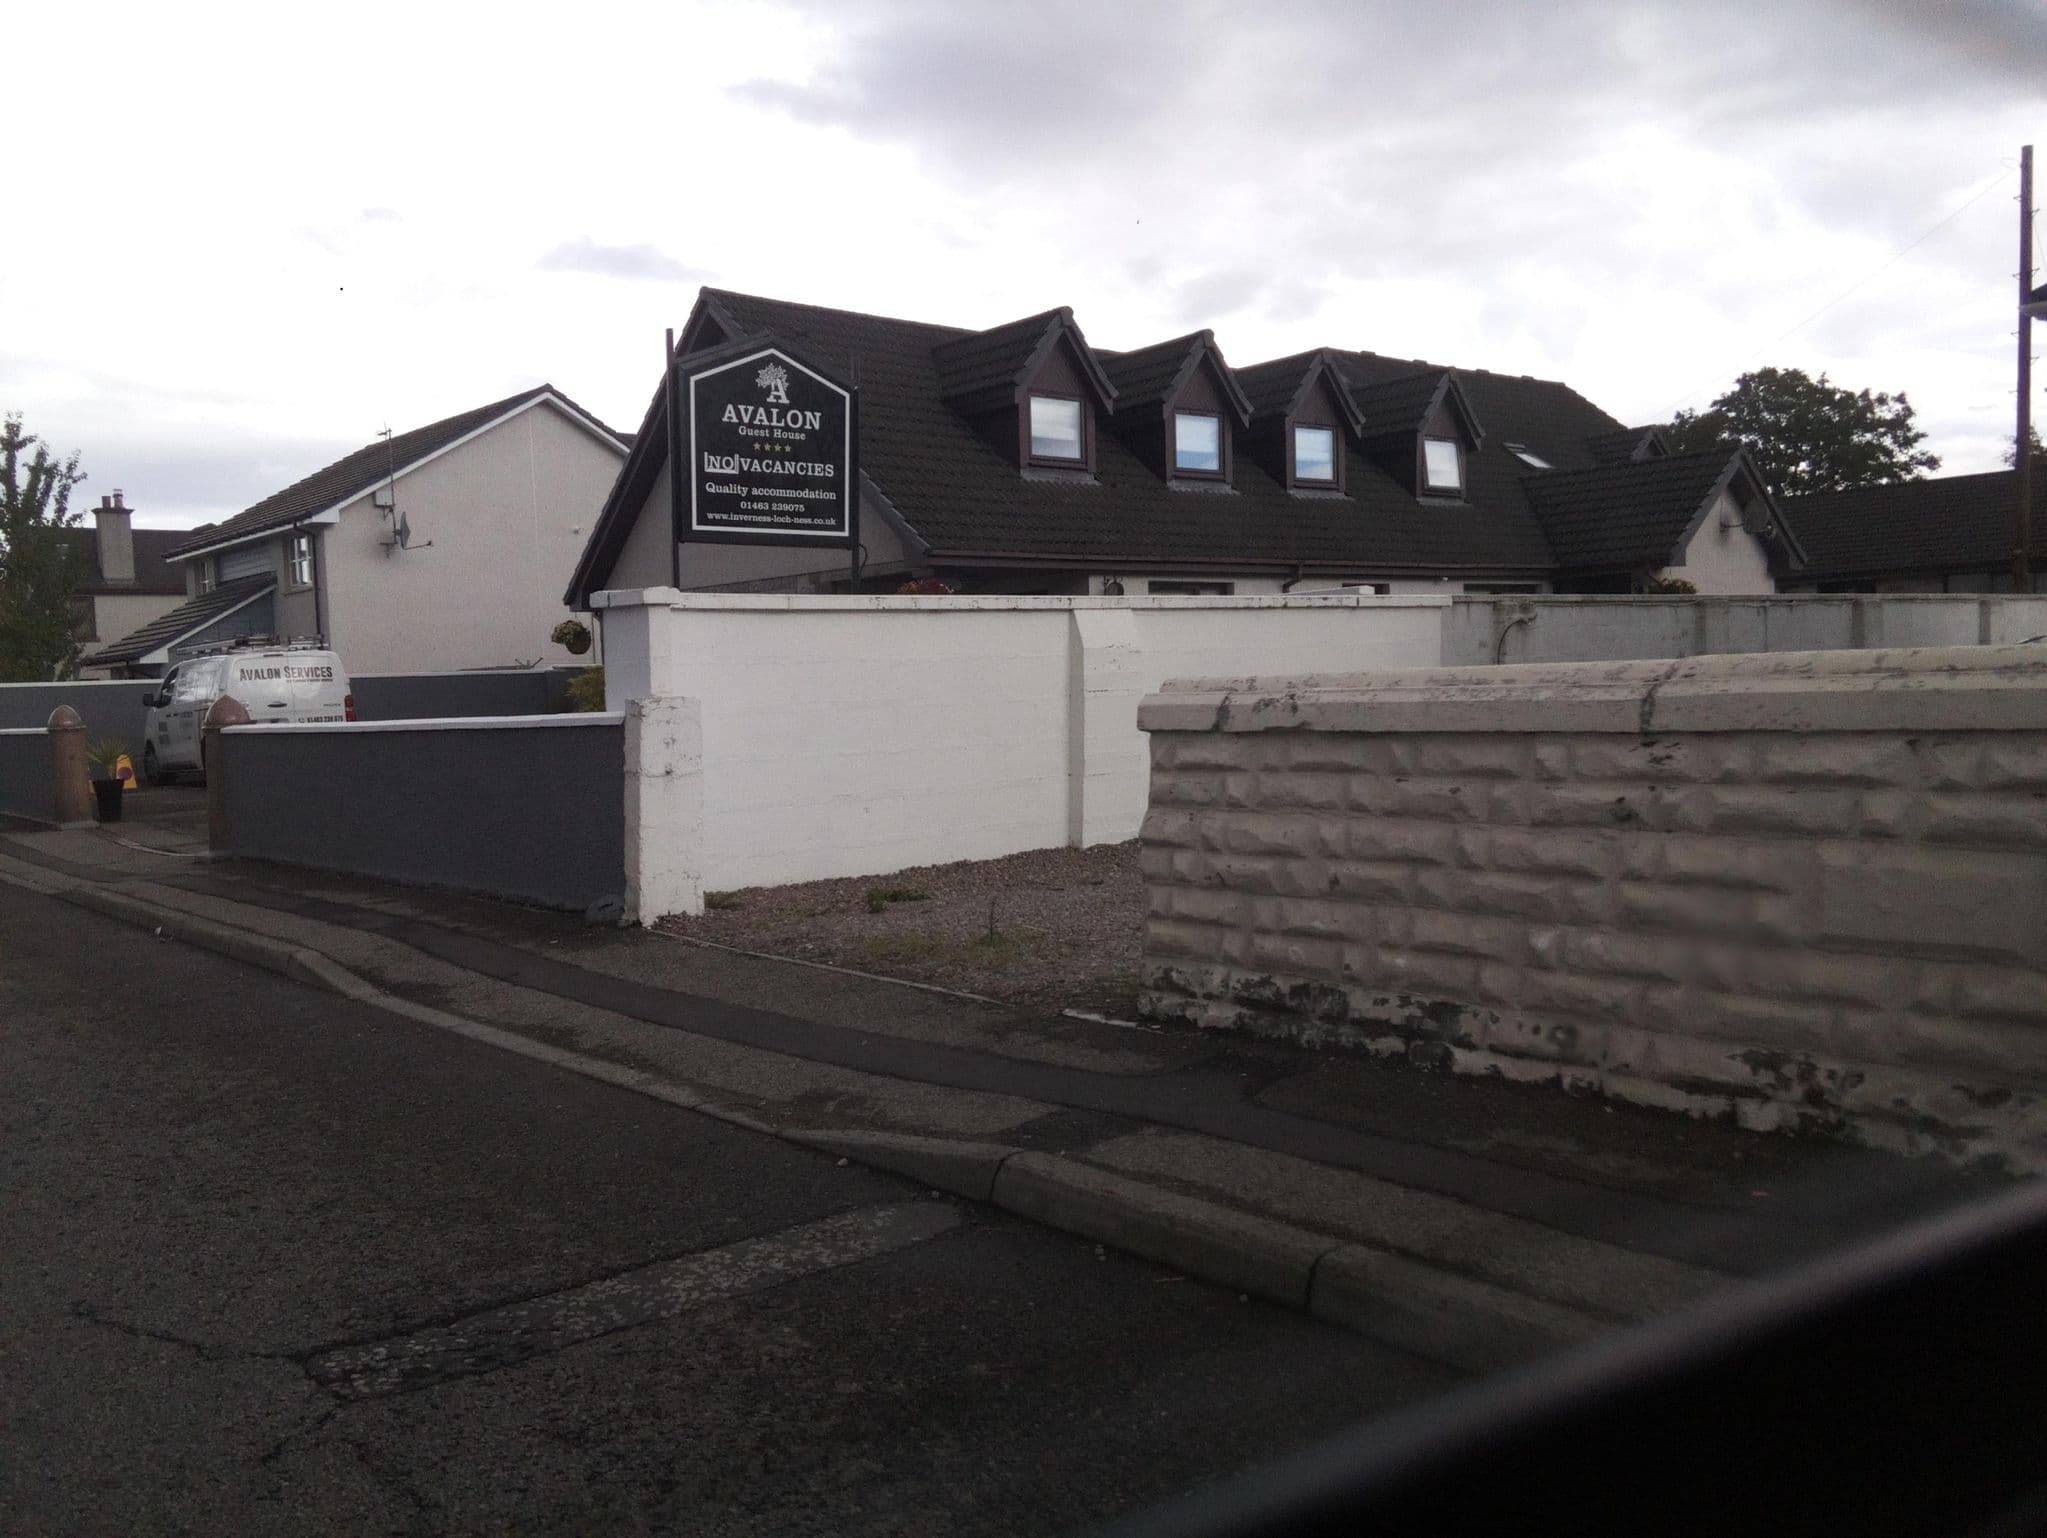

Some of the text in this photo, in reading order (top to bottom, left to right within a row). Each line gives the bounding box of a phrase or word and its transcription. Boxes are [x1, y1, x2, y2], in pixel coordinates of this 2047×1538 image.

[722, 404, 822, 430] AVALON
[738, 426, 806, 440] Guest House
[709, 455, 835, 477] NO VACANCIES
[705, 482, 837, 499] Quality accommodation
[740, 502, 805, 512] 01463 239075
[240, 666, 333, 682] AVALON SERVICES
